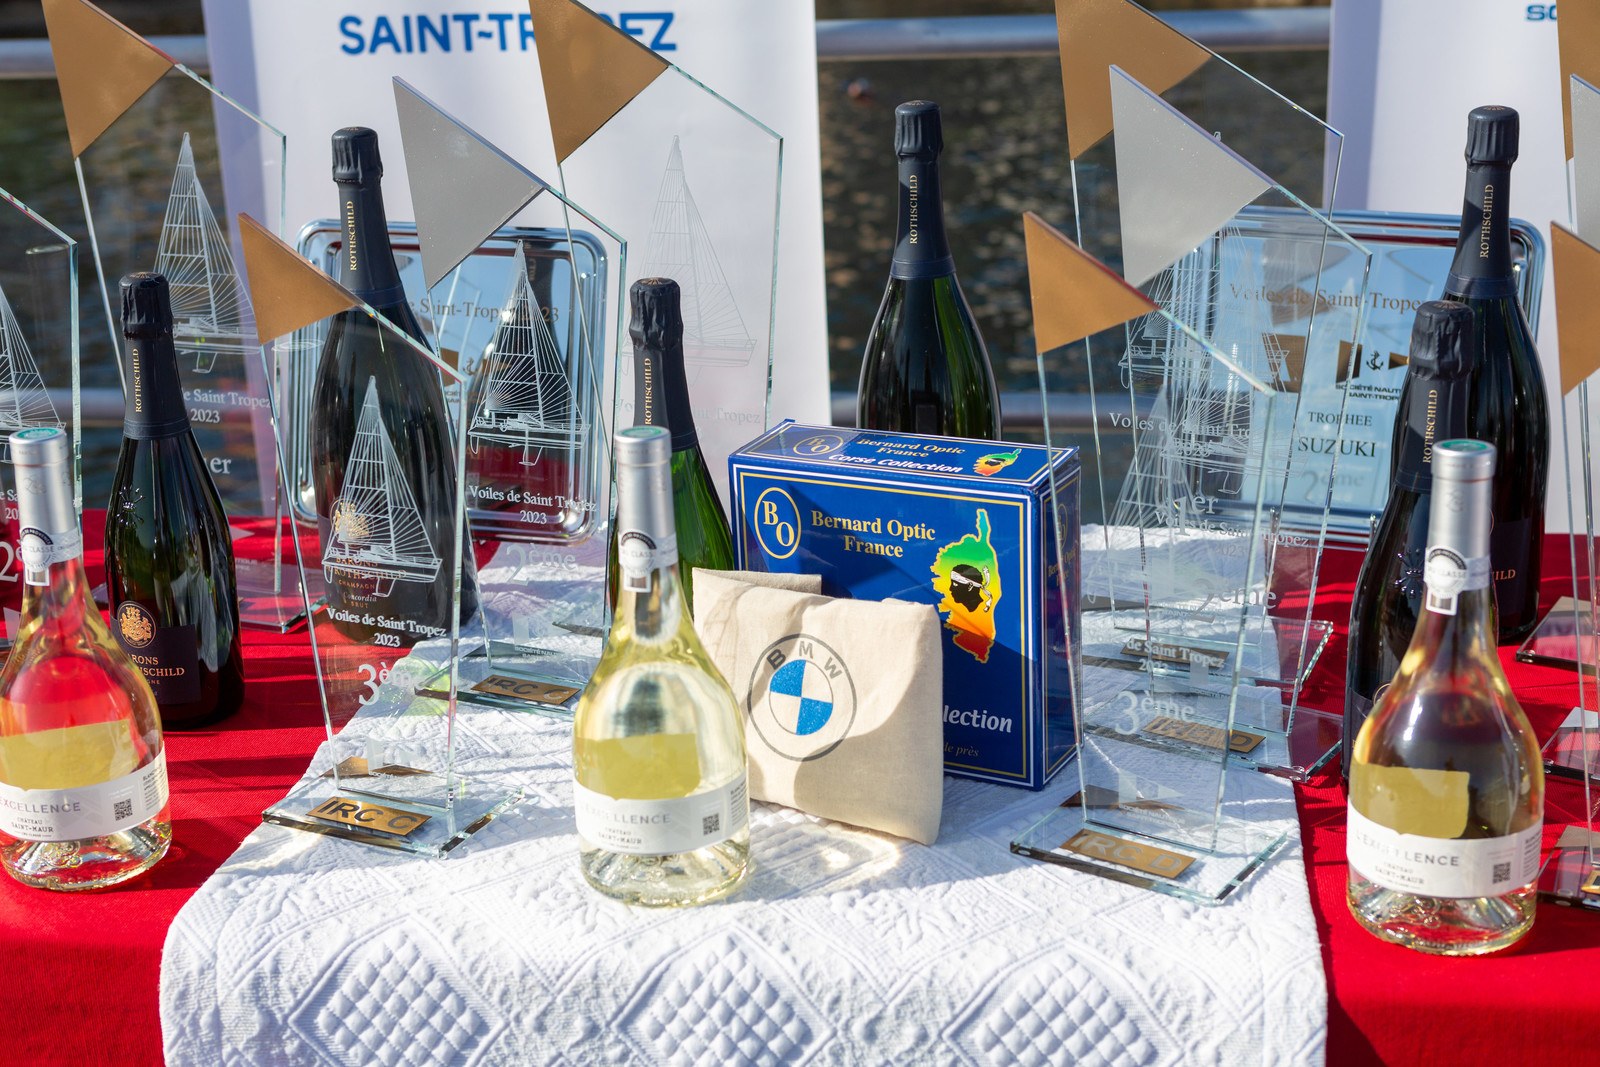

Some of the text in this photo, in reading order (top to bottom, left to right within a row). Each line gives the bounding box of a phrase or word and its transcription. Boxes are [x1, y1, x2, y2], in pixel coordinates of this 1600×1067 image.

[339, 12, 677, 56] SAINT-TREZ
[909, 174, 918, 245] ROTHSCHILD
[1479, 184, 1494, 259] ROTHSCHILD
[346, 200, 358, 271] ROTHSCHILD
[1317, 289, 1421, 315] Saint-Trope
[132, 348, 143, 414] ROTHSCHILD
[193, 388, 225, 404] Saint
[644, 357, 653, 426] ROTHSCHILD
[190, 408, 220, 424] 2023
[1109, 412, 1154, 431] Voles
[1422, 389, 1438, 464] ROTHSCHILD
[856, 438, 966, 455] Bernard Optic
[875, 447, 929, 458] France
[1298, 437, 1377, 458] SUZUKI
[828, 453, 963, 473] Corse Collection
[469, 485, 597, 513] Voiles de Saint Tropez
[520, 509, 547, 525] 2023
[811, 510, 936, 542] Bernard Optic
[1155, 511, 1200, 529] Voies
[844, 535, 904, 559] France
[506, 543, 577, 585] 2ème
[326, 607, 447, 638] Voiles de Saint Tropez
[374, 632, 401, 648] 2023
[1126, 637, 1141, 651] de
[1144, 640, 1178, 659] Saint
[1179, 647, 1225, 669] Tropez
[766, 640, 842, 680] BMW
[357, 661, 414, 706] 3èm
[481, 676, 570, 701] IRC C
[942, 704, 1013, 734] lection
[1115, 690, 1195, 735] 3ème
[955, 745, 980, 758] près
[1229, 733, 1254, 748] D
[318, 800, 418, 830] IRC C
[1071, 832, 1181, 872] IRC D
